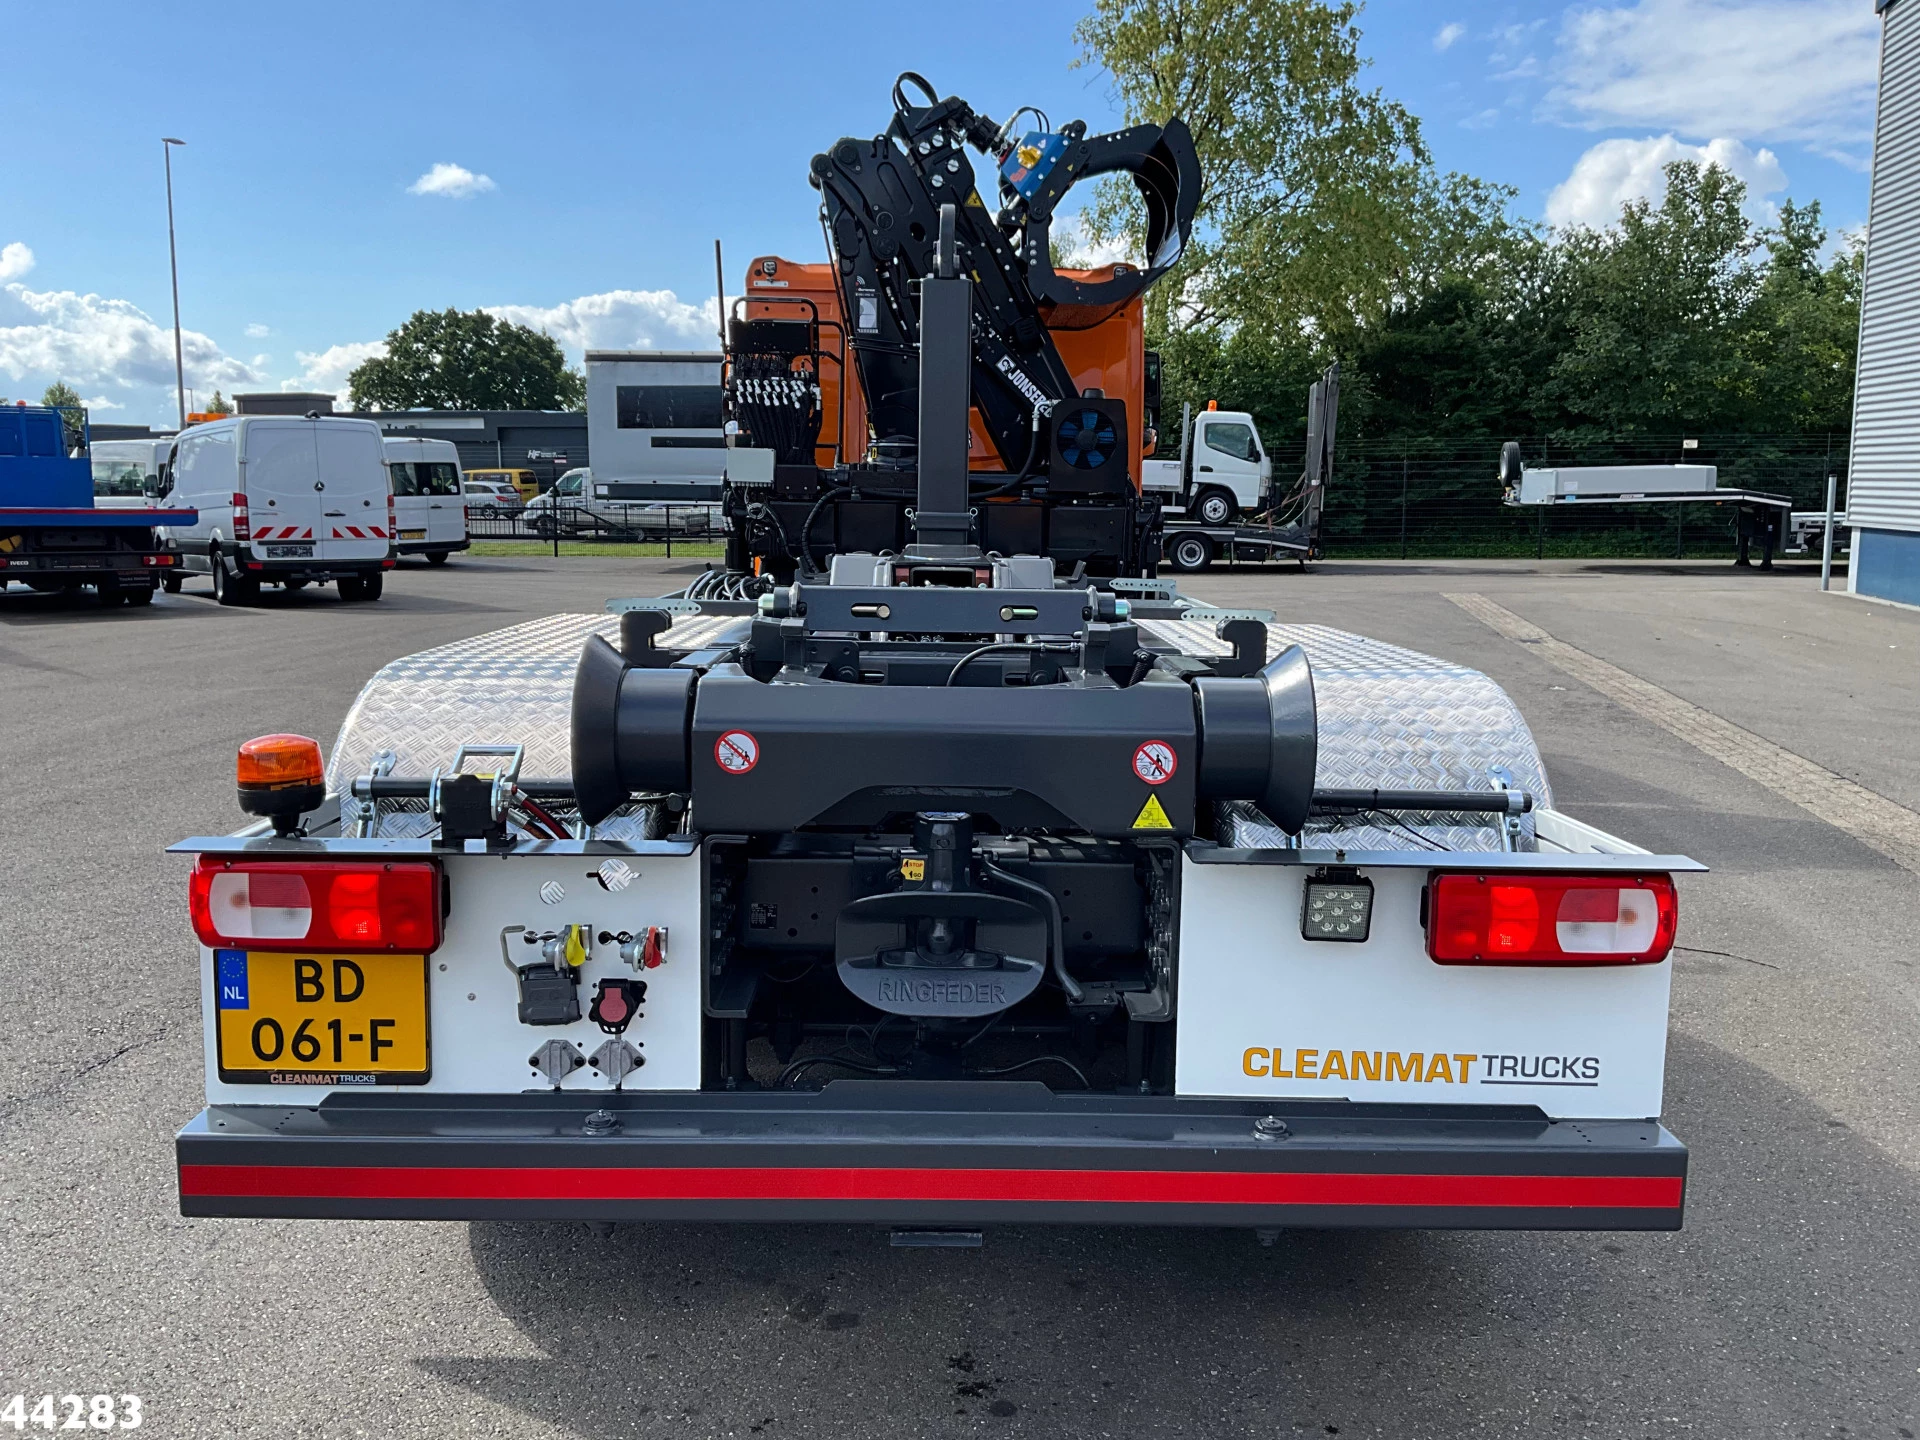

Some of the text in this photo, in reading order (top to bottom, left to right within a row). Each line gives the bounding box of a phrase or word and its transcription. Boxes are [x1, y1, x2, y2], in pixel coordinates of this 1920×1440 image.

[224, 986, 245, 1000] NL
[294, 958, 365, 1003] BD
[878, 977, 1007, 1004] RINGFEDER
[251, 1017, 396, 1063] 061-F
[270, 1073, 376, 1085] CLEANMAT TRUCKS
[1242, 1047, 1600, 1084] CLEANMAT TRUCKS
